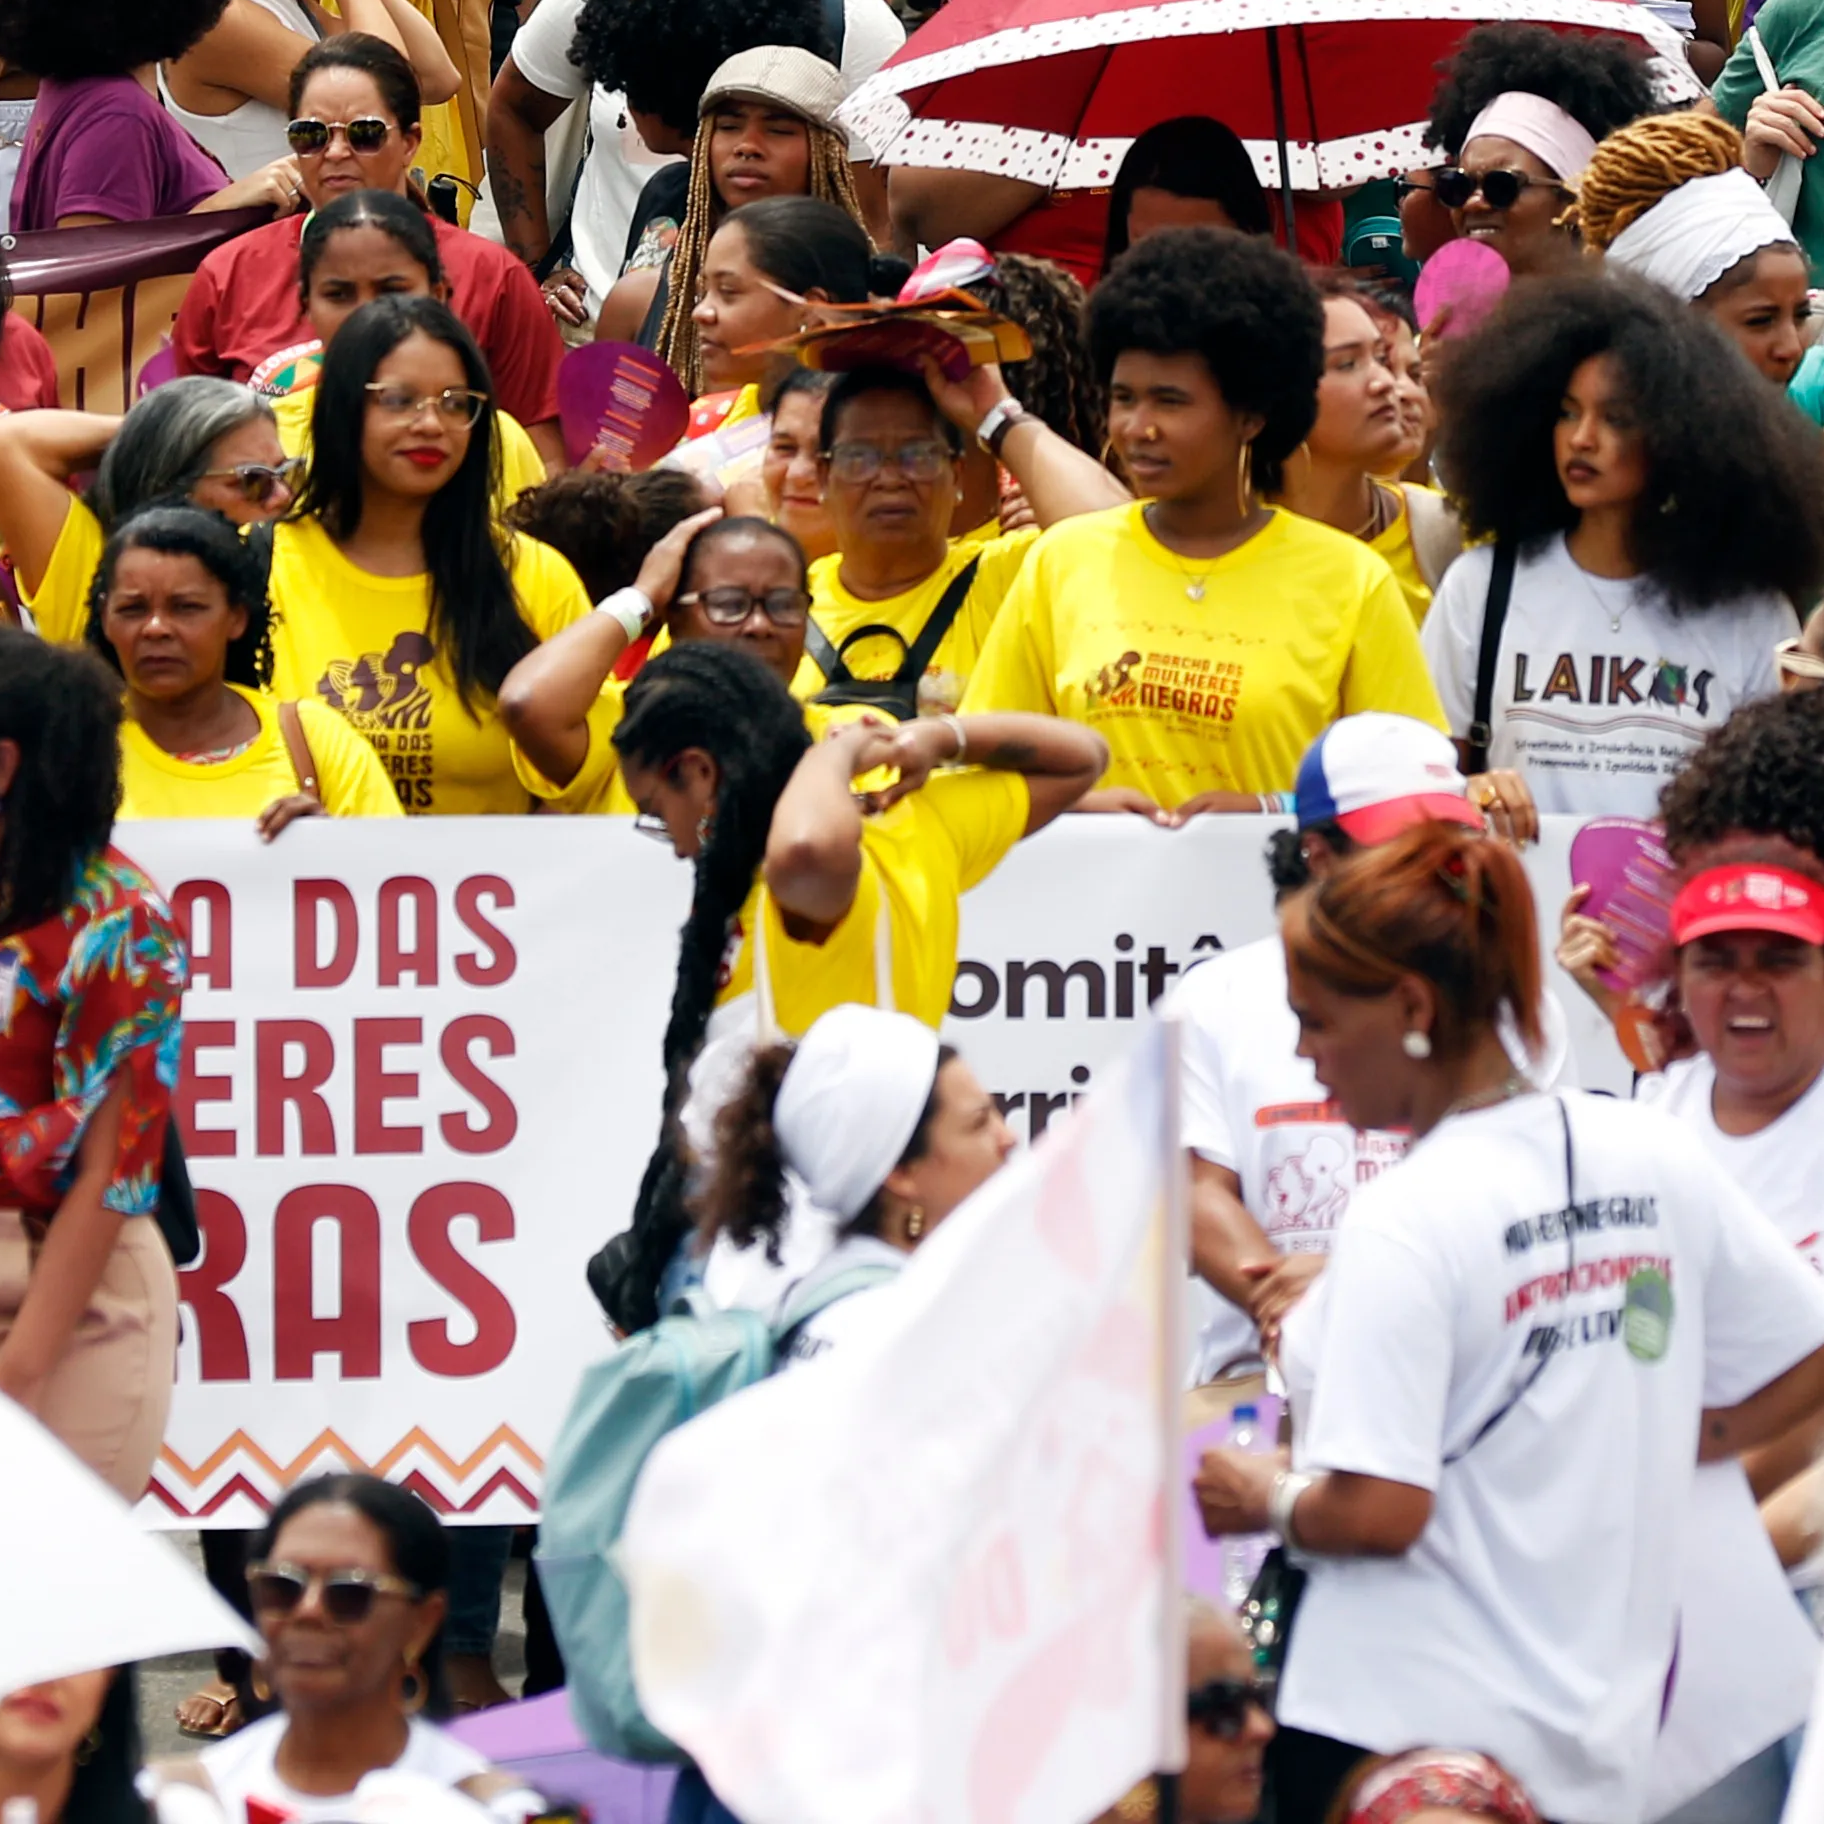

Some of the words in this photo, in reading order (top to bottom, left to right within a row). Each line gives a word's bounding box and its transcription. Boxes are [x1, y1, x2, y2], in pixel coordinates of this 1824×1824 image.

[1139, 681, 1237, 723] NEGRAS
[1142, 665, 1241, 695] MULHERES
[172, 878, 234, 990] A
[291, 873, 518, 990] DAS
[180, 1013, 518, 1159] ERES
[175, 1179, 518, 1383] RAS
